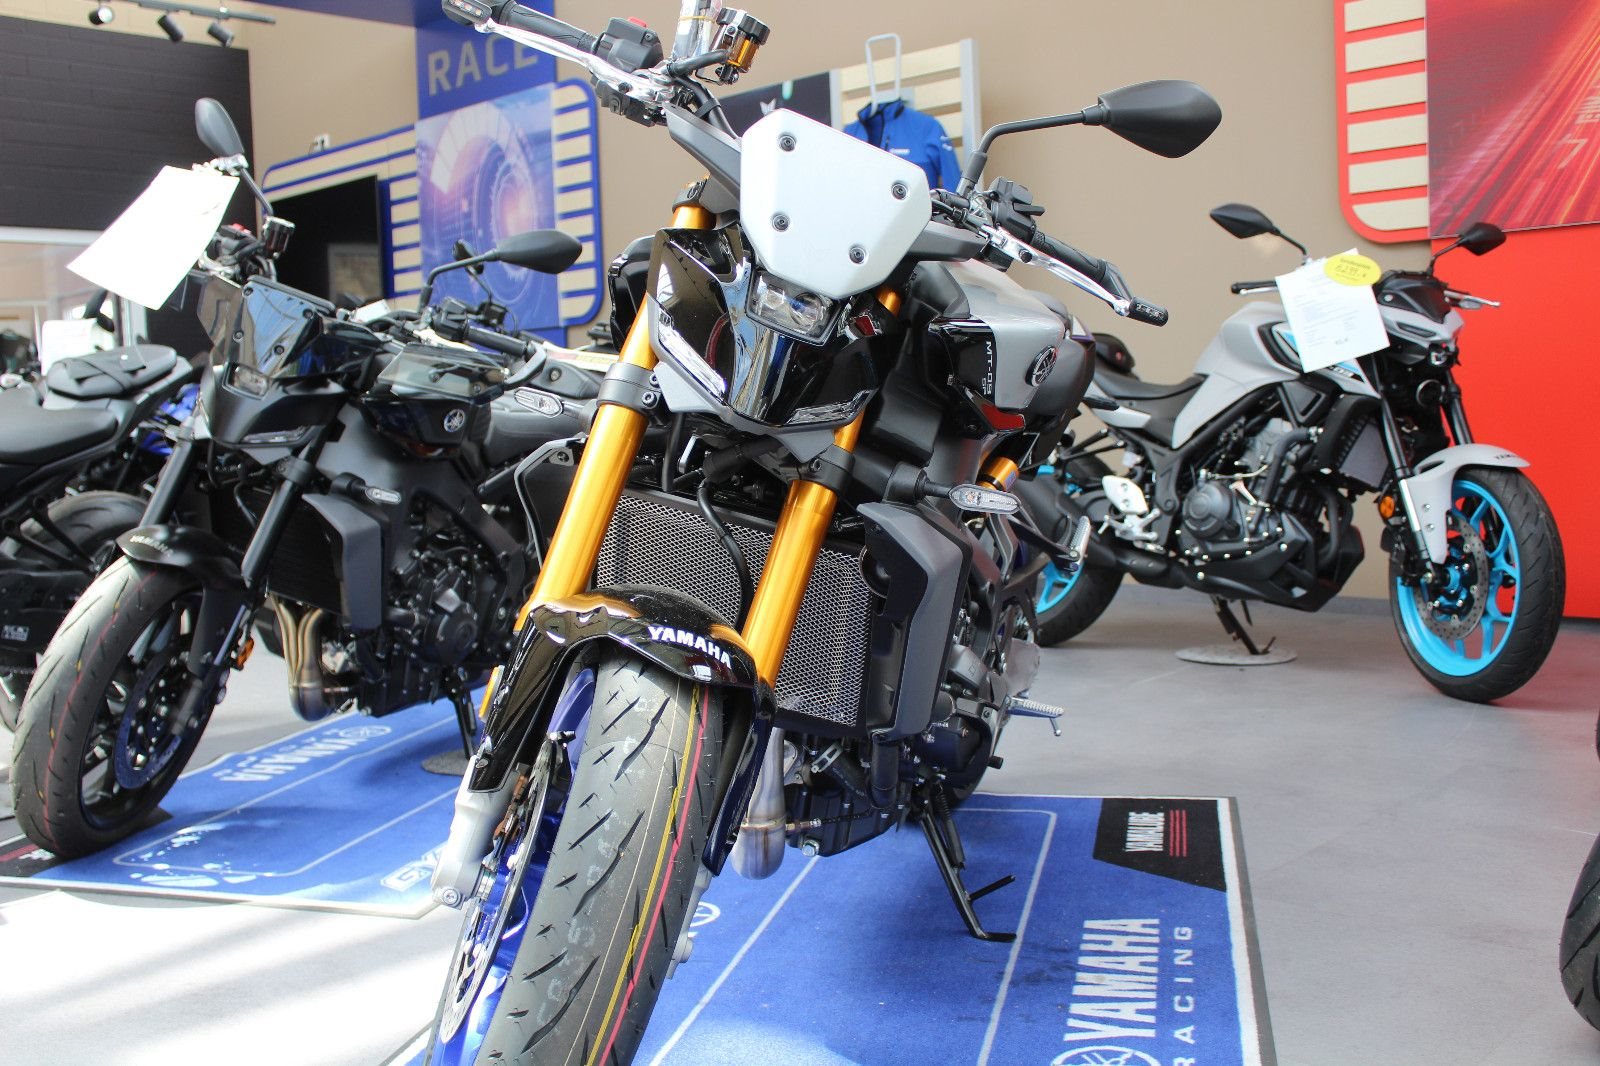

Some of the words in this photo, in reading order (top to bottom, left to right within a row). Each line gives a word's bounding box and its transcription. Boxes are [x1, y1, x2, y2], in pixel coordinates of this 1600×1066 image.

[647, 625, 732, 670] YAMAHA
[1124, 811, 1165, 852] YAMALUBE
[1063, 918, 1161, 1042] YAMAHA
